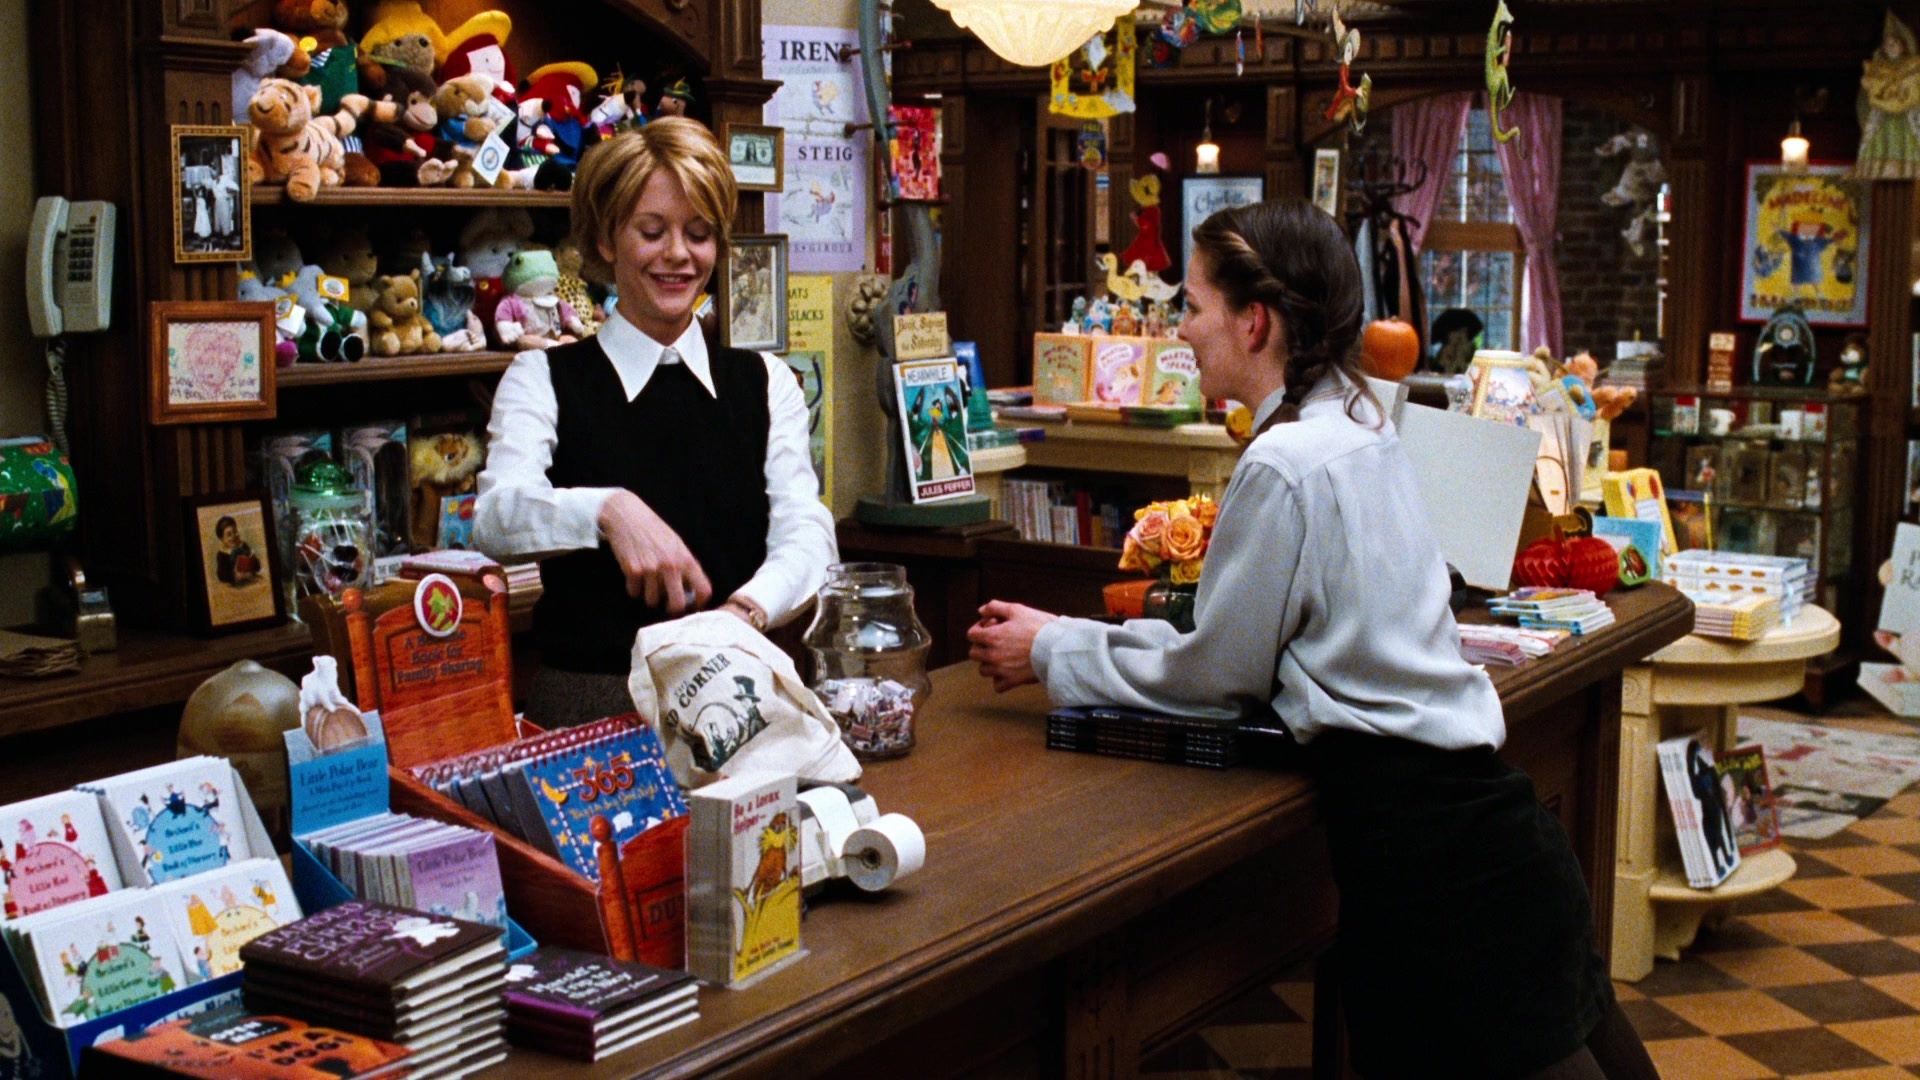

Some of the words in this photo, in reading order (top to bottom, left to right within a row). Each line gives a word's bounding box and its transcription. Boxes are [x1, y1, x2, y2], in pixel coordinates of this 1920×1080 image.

[798, 146, 852, 161] STEIG
[920, 485, 944, 498] JULES
[678, 653, 731, 709] CORNER
[329, 762, 354, 779] Polar
[356, 758, 380, 772] Bear
[573, 755, 634, 802] 365
[252, 900, 367, 947] HAROLD
